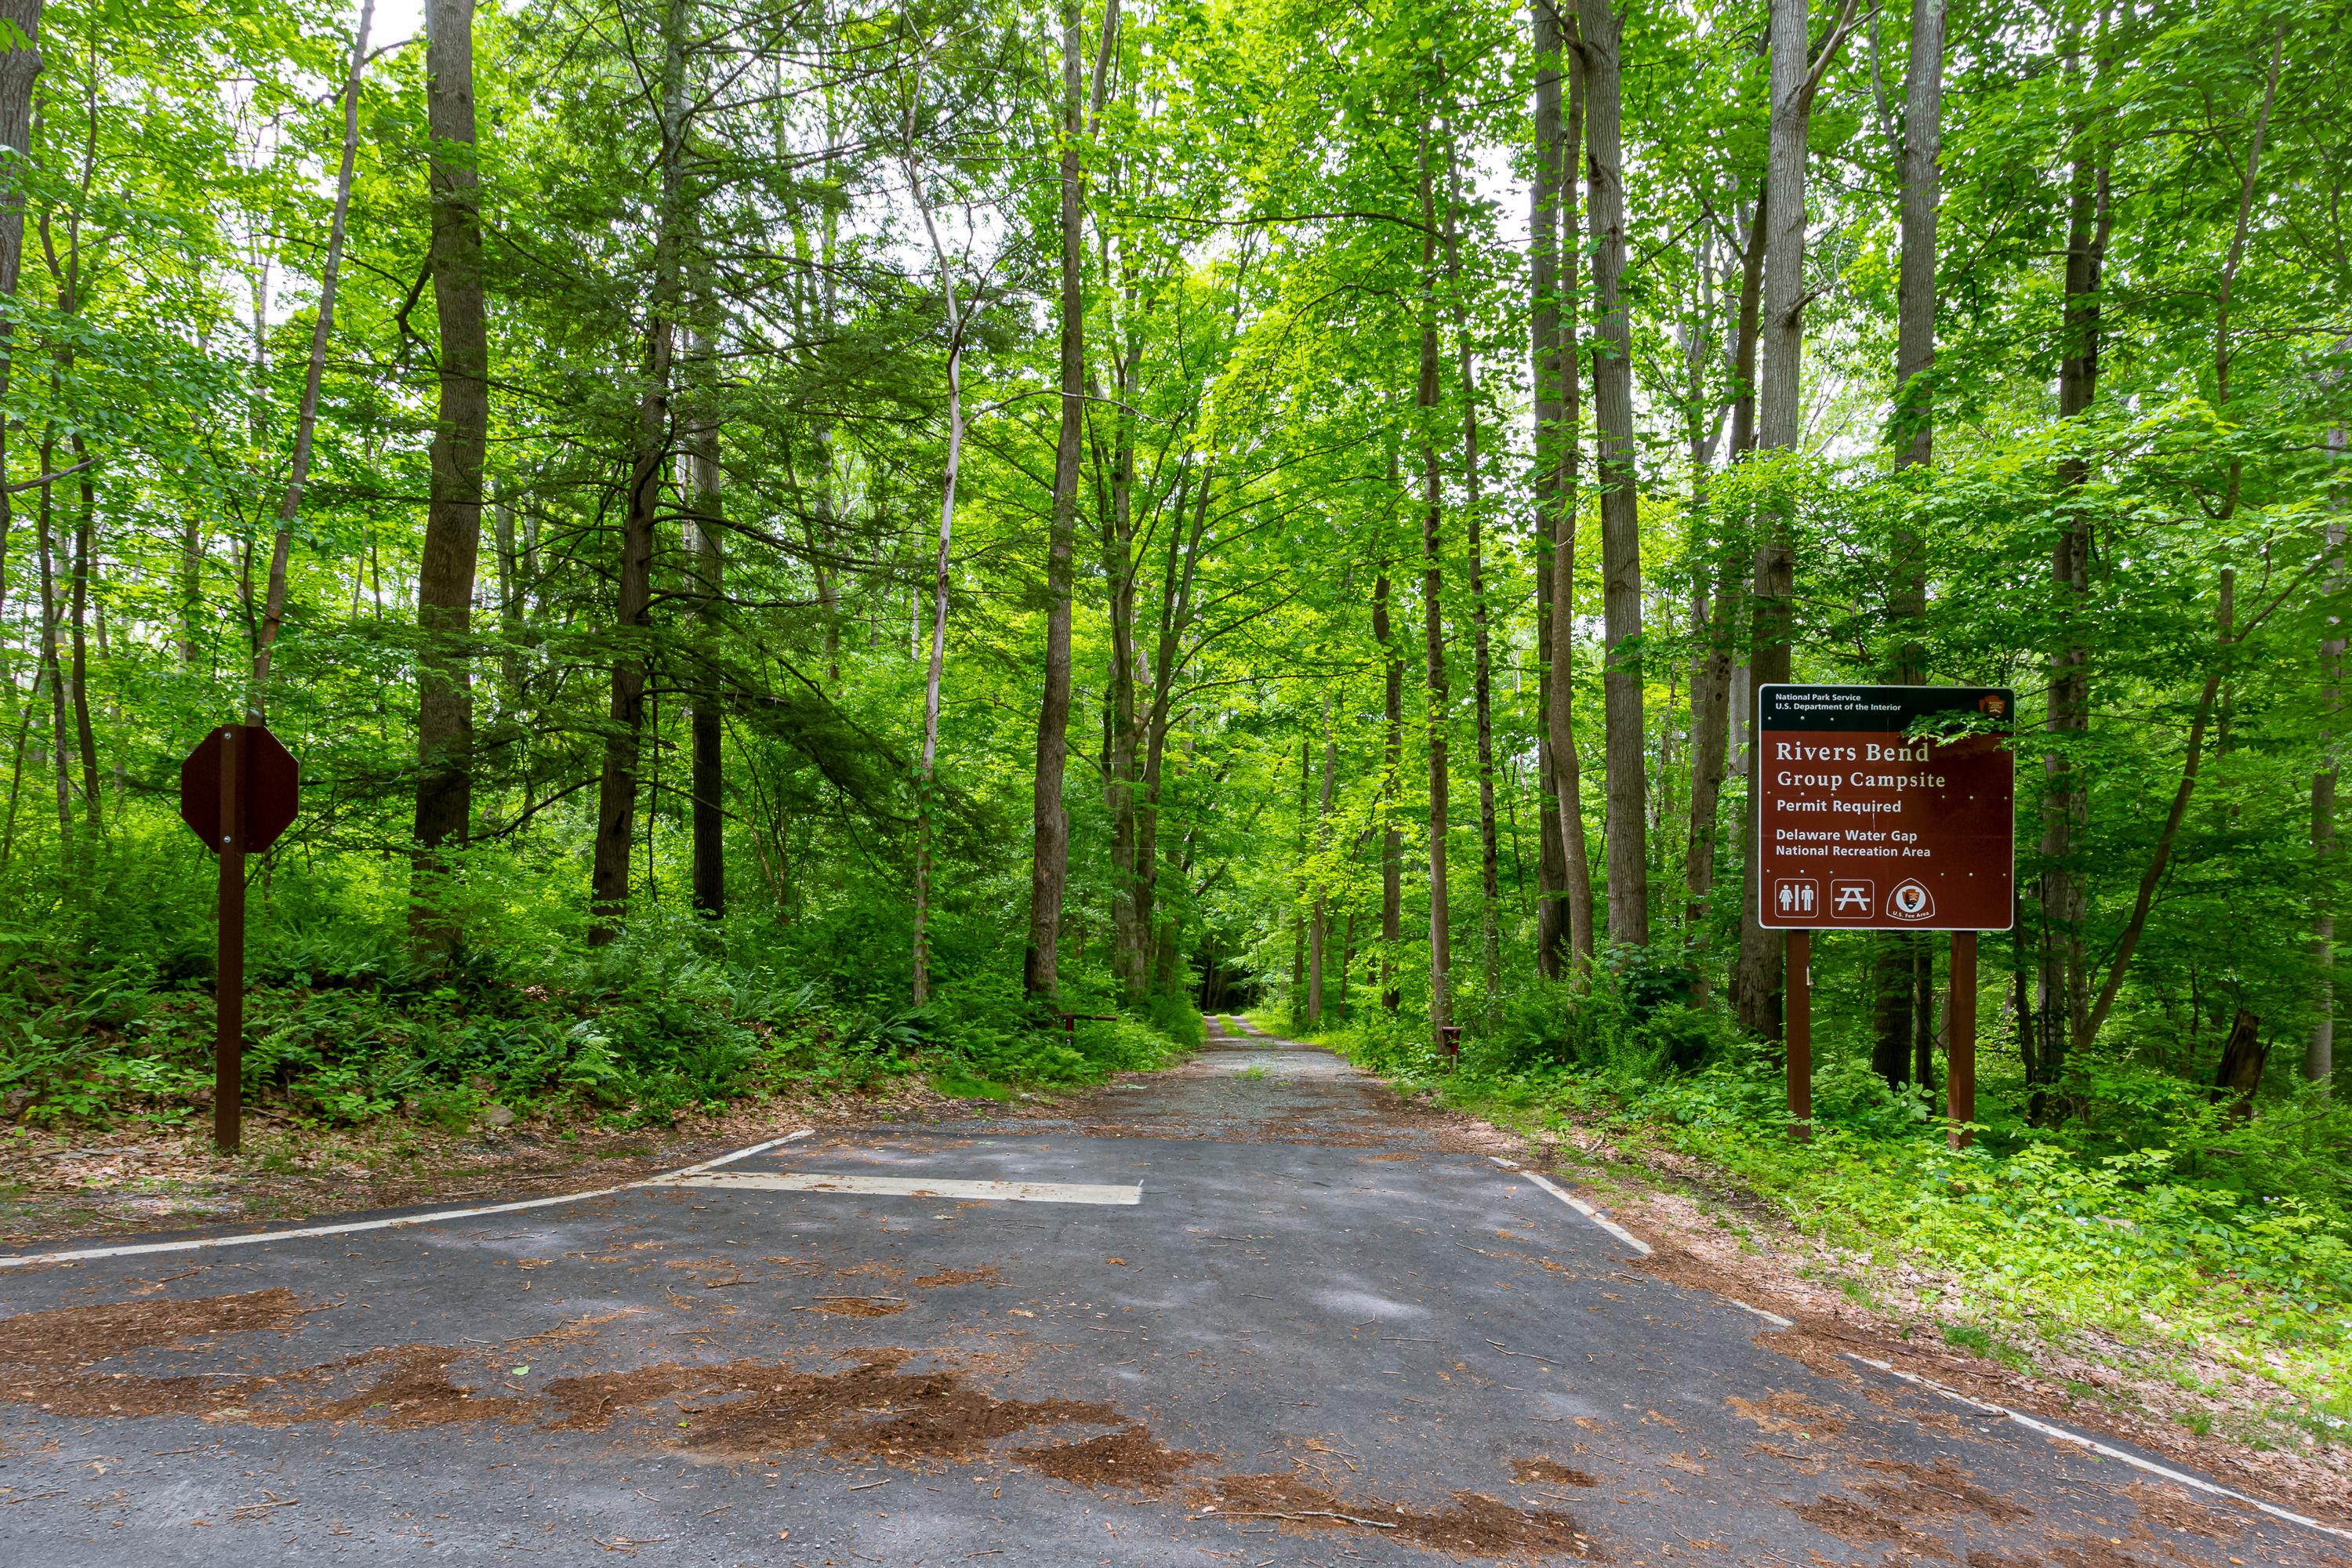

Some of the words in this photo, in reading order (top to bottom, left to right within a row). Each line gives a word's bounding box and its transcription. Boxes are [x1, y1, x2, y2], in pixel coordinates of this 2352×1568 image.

[1777, 742, 1857, 760] Rivers
[1866, 743, 1929, 761] Bend
[1777, 771, 1842, 790] Group
[1850, 772, 1945, 791] Campsite
[1777, 800, 1827, 811] Permit
[1833, 800, 1901, 815] Required
[1777, 829, 1840, 840] Delaware
[1846, 830, 1886, 841] Water
[1891, 830, 1917, 844] Gap
[1776, 846, 1828, 856] National
[1833, 847, 1898, 856] Recreation
[1903, 848, 1930, 857] Area
